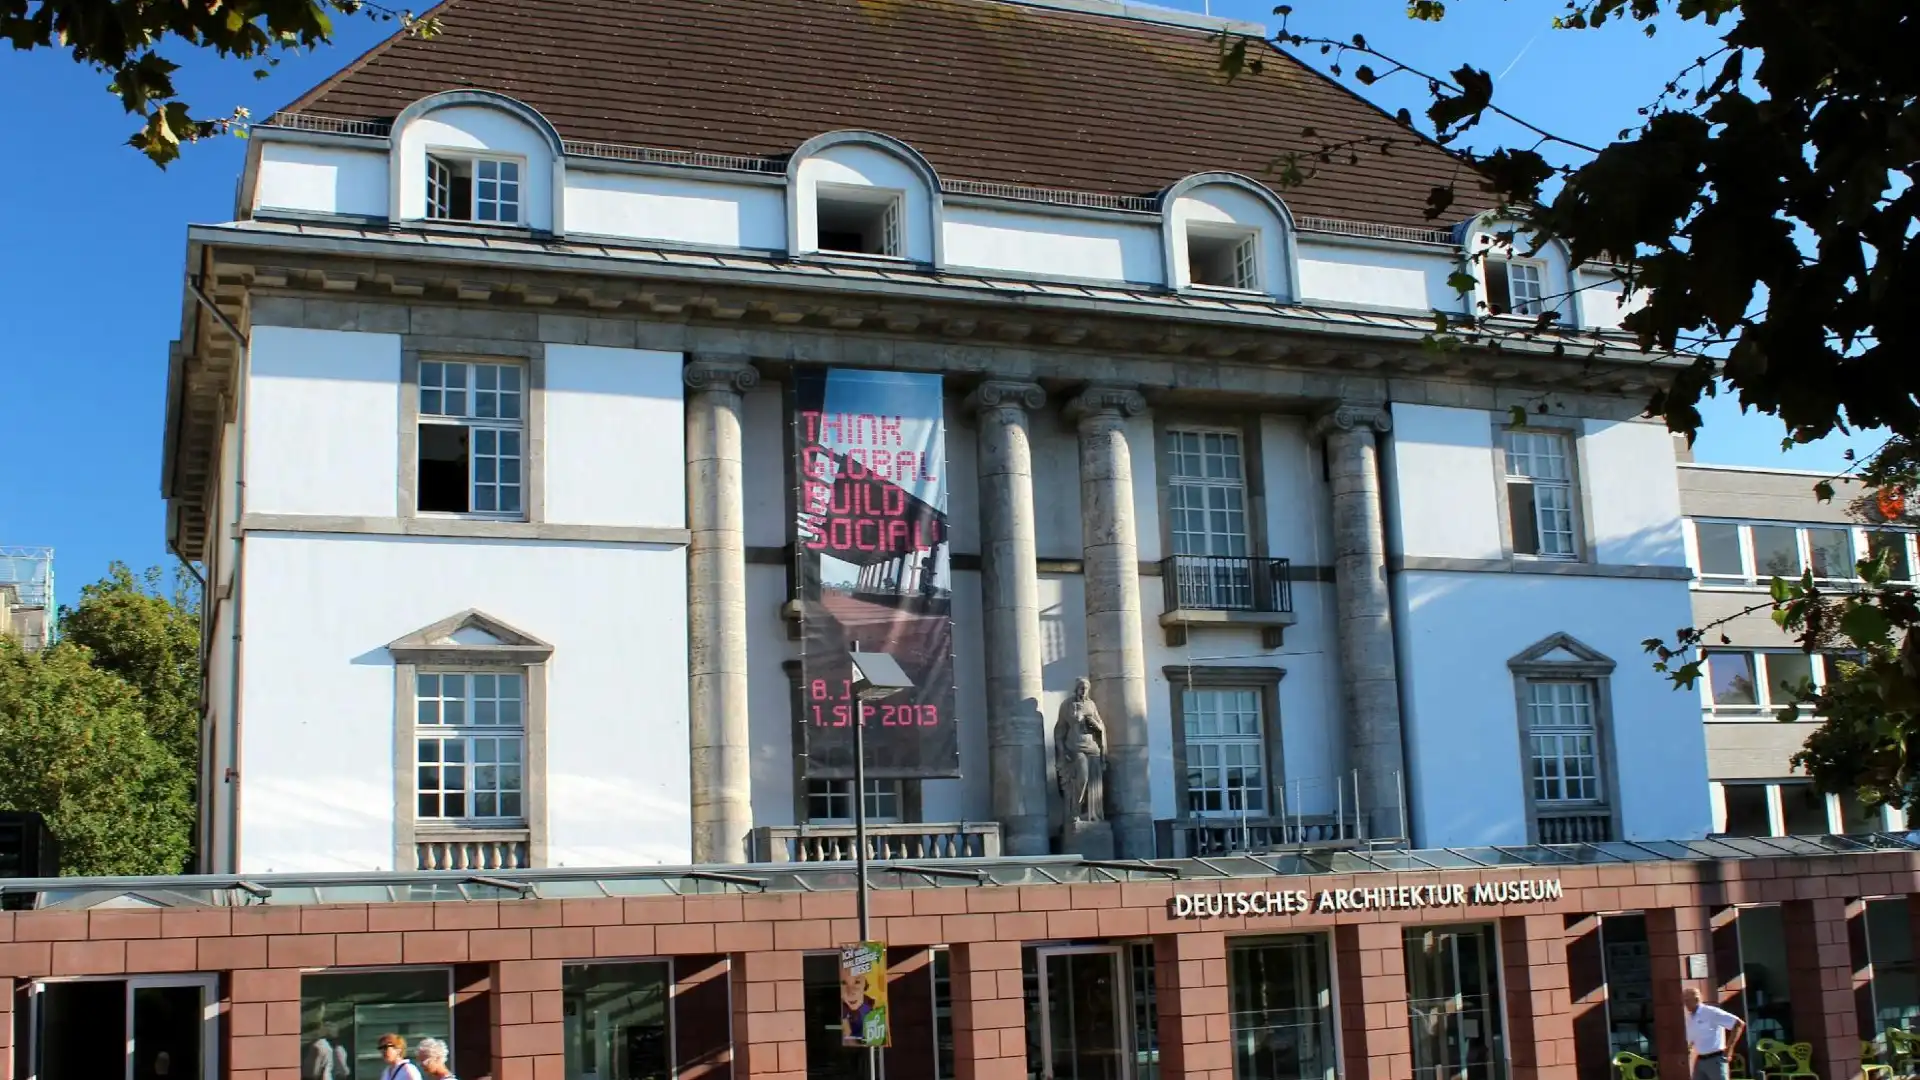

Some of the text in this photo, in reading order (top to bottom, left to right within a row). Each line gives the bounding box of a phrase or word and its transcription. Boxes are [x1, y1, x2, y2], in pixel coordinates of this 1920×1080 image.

[803, 411, 902, 446] THINK
[803, 446, 937, 481] GLOBAL
[804, 480, 904, 516] BUILD
[812, 679, 833, 700] 8.
[881, 704, 938, 726] 2013
[1175, 878, 1563, 917] DEUTSCHES ARCHITEKTUR MUSEUM
